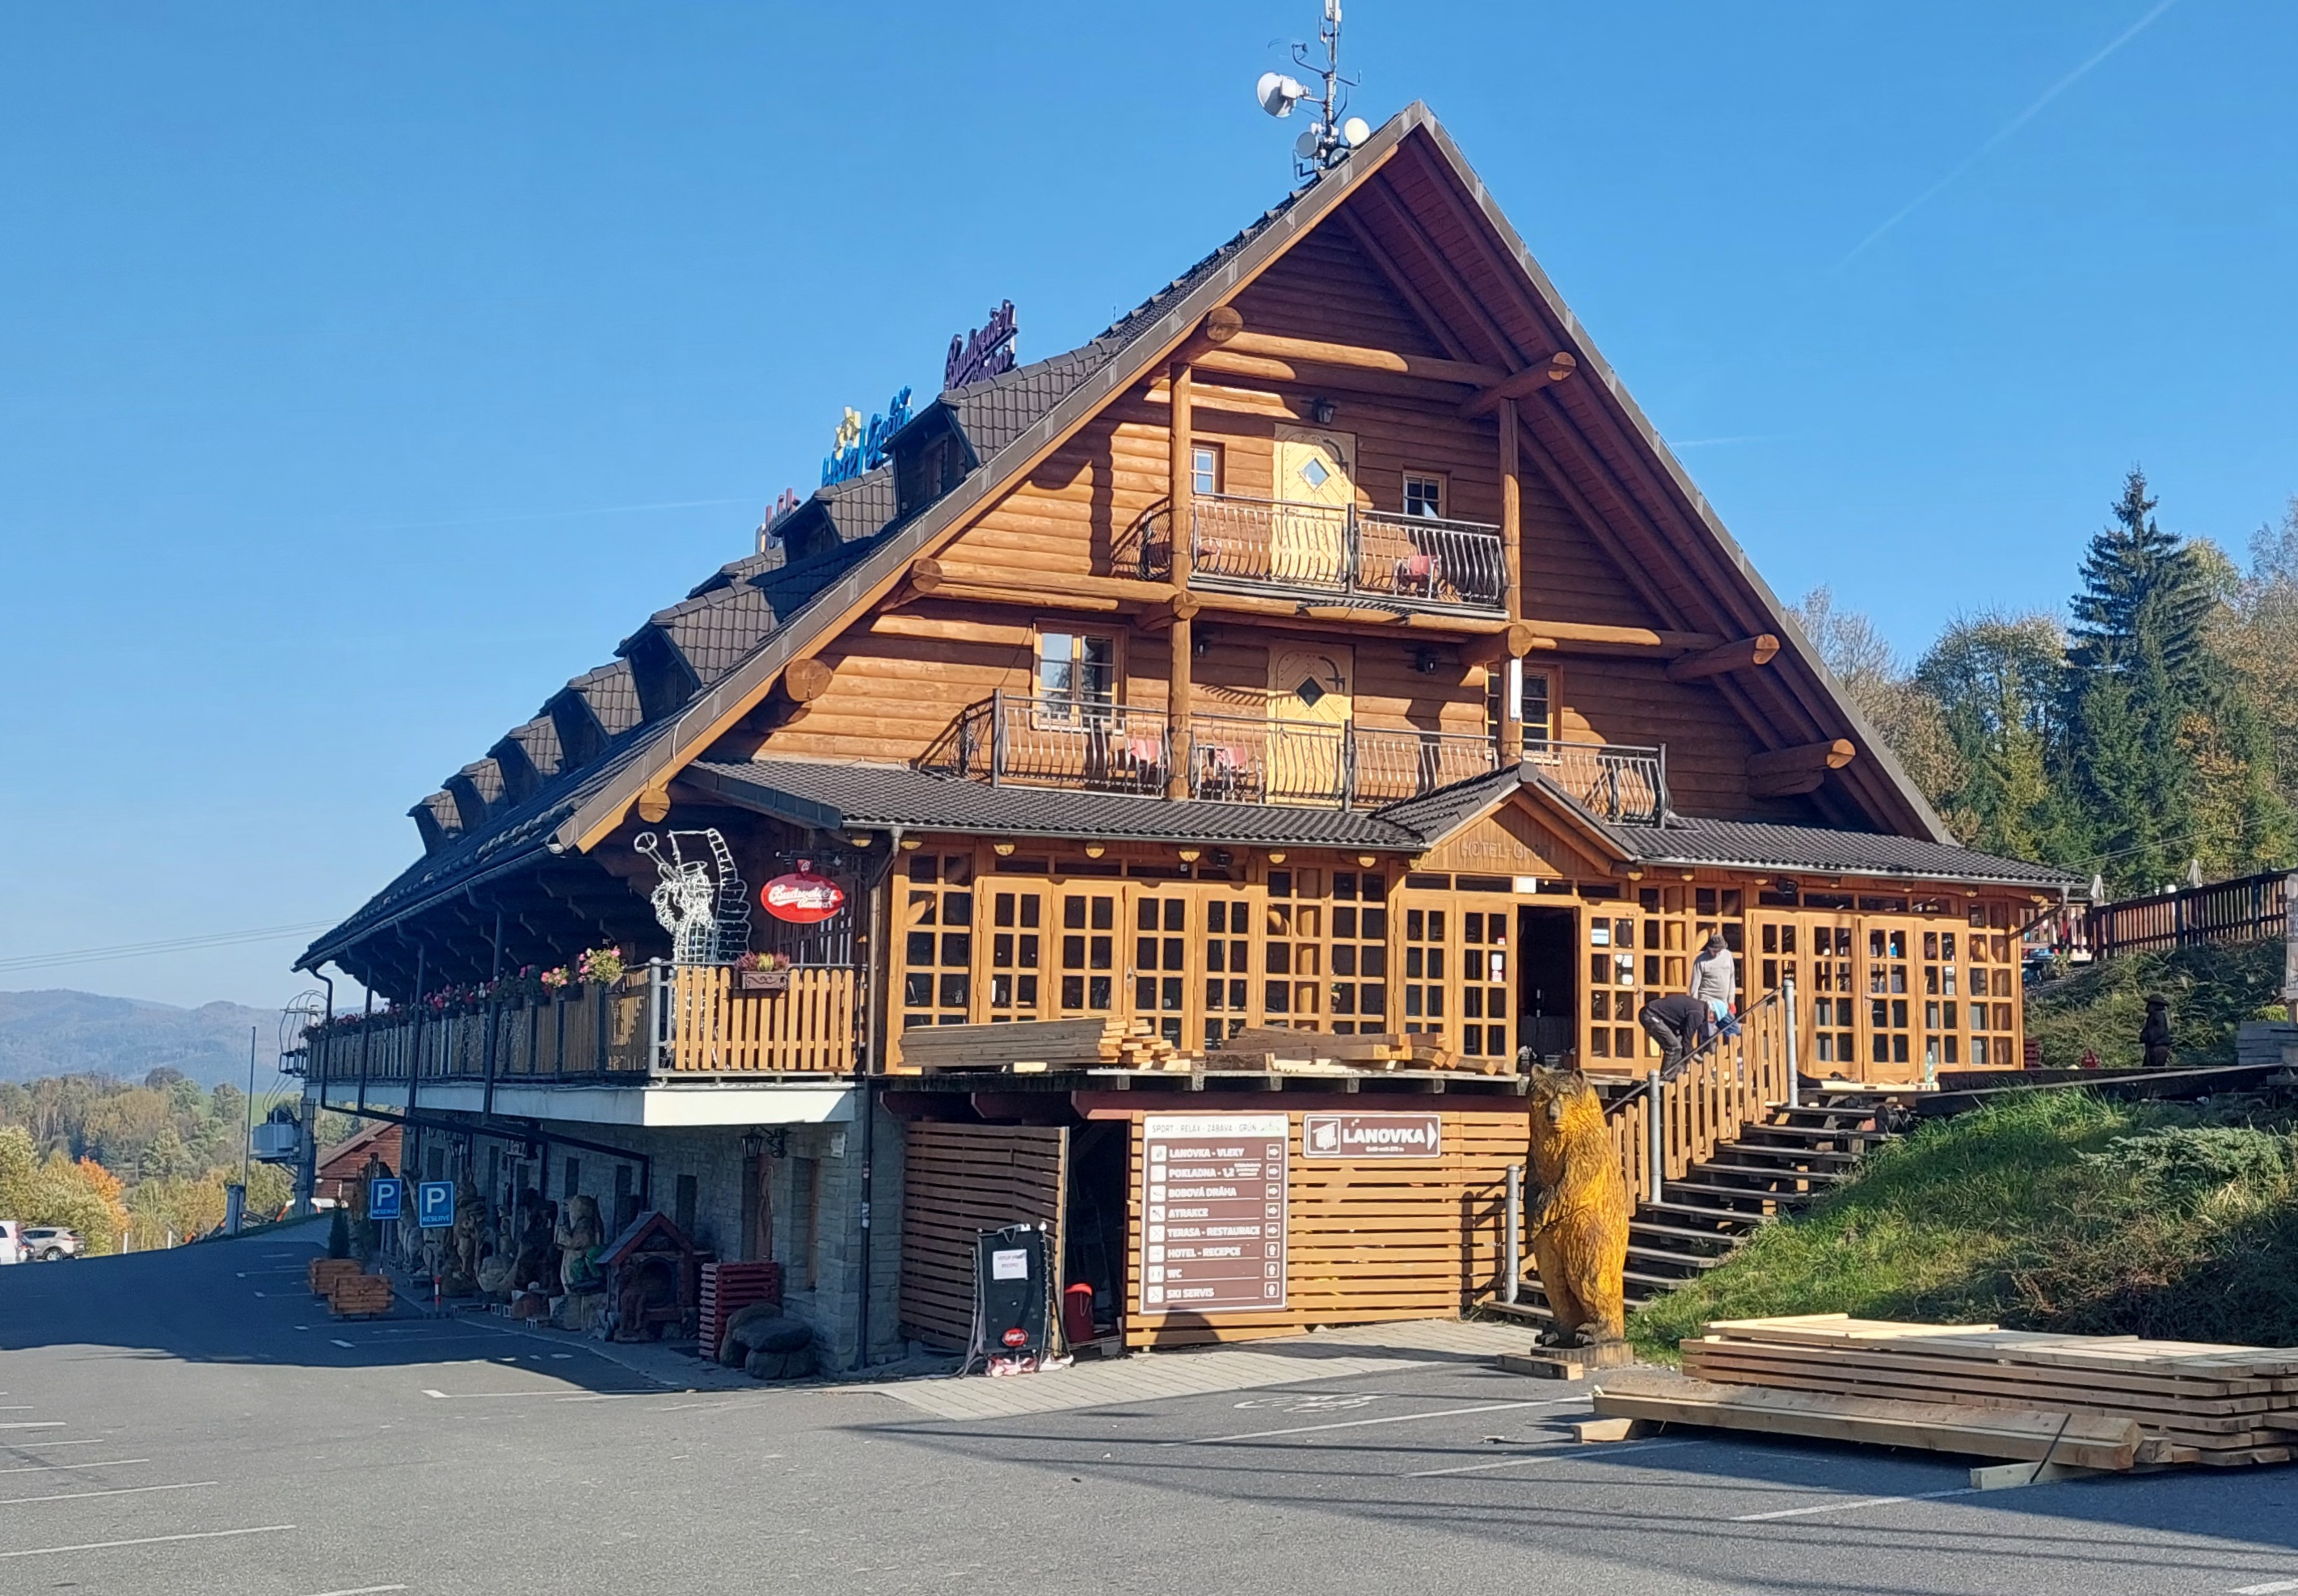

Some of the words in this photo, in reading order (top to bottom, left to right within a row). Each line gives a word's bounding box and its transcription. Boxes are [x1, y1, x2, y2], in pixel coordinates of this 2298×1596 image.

[768, 883, 838, 904] Budweiser
[1152, 1124, 1174, 1133] SPORT
[1180, 1124, 1200, 1132] RELAX
[1343, 1128, 1426, 1143] LANOVKA
[1169, 1148, 1211, 1158] LANOVKA
[1216, 1148, 1245, 1157] VLEKY
[1169, 1168, 1216, 1177] POKLADNA
[377, 1184, 395, 1206] P
[1168, 1186, 1205, 1198] BOBOVÁ
[1206, 1186, 1238, 1197] DRÁHA
[427, 1187, 446, 1213] P
[1168, 1207, 1209, 1219] ATRAKCE
[1167, 1228, 1201, 1238] TERASA
[1206, 1226, 1261, 1236] RESTAURACE
[1167, 1248, 1196, 1258] HOTEL
[1202, 1247, 1242, 1257] RECEPCE
[1166, 1269, 1183, 1278] WC
[1166, 1289, 1182, 1299] SKI
[1183, 1288, 1215, 1298] SERVIS
